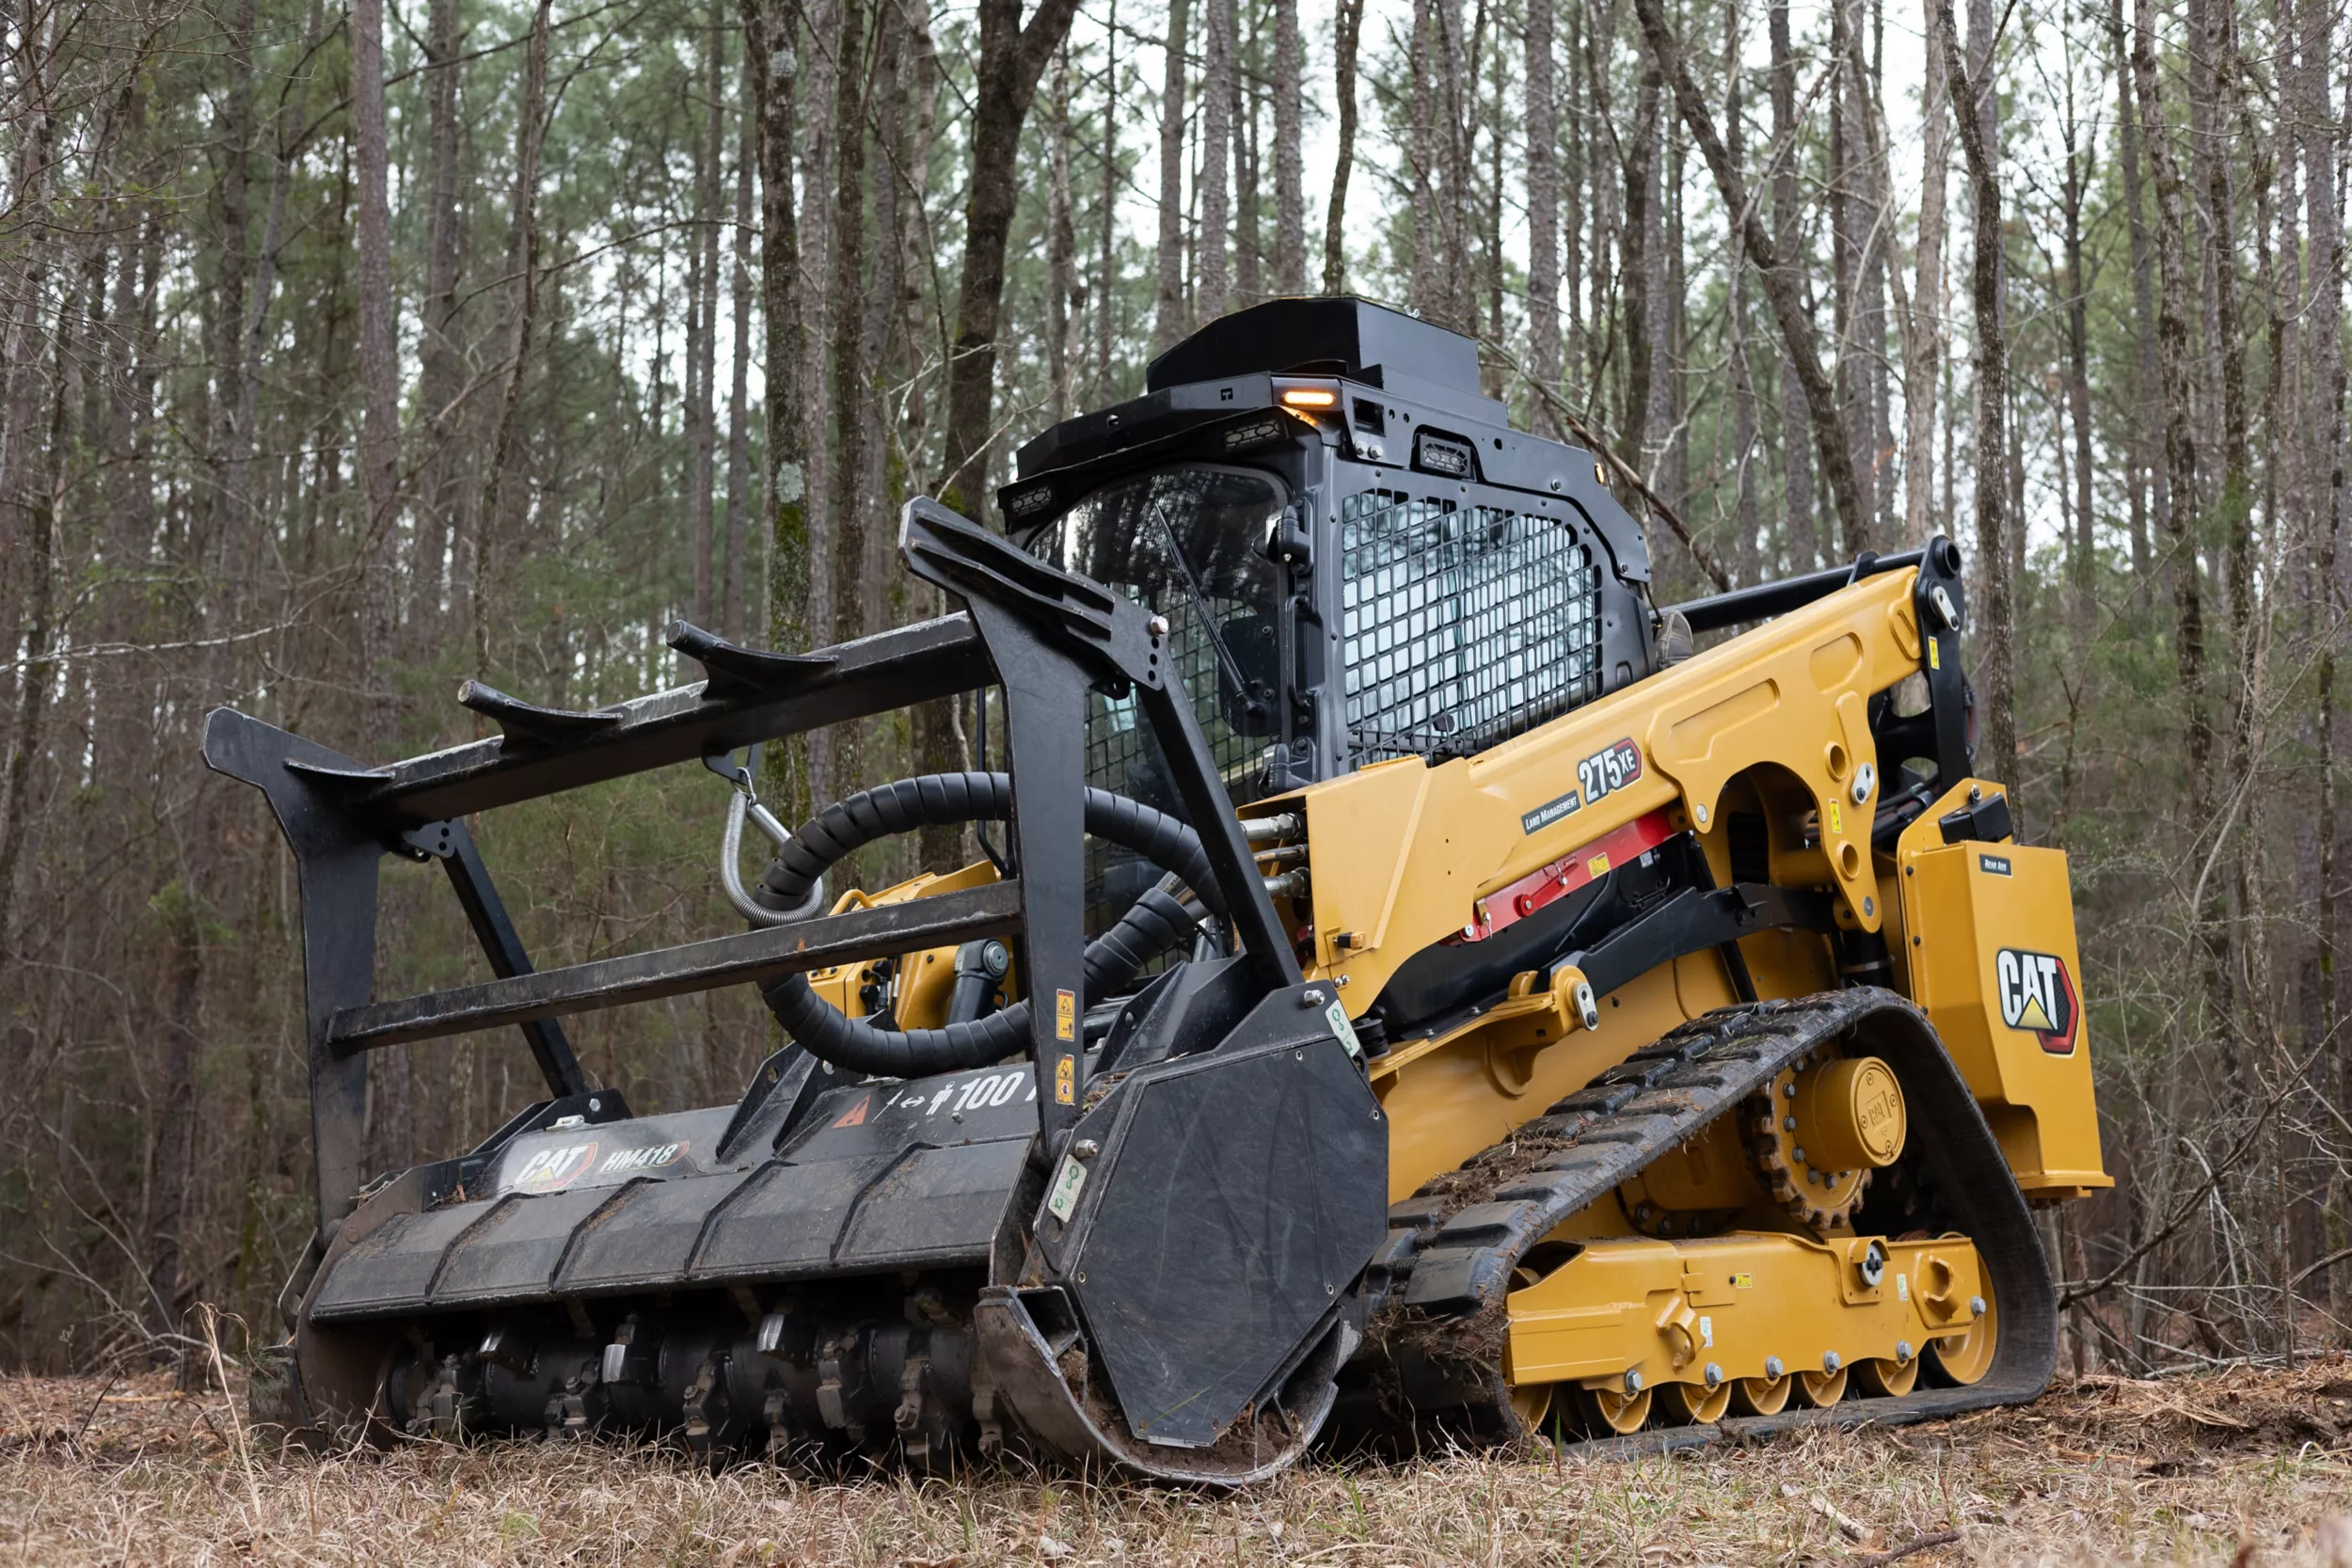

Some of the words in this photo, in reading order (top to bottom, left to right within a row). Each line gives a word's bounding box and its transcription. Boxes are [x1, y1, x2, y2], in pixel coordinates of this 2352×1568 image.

[1998, 950, 2058, 1030] CAT
[954, 1071, 1025, 1111] 100
[516, 1146, 589, 1184] CAT
[599, 1144, 678, 1172] HM418
